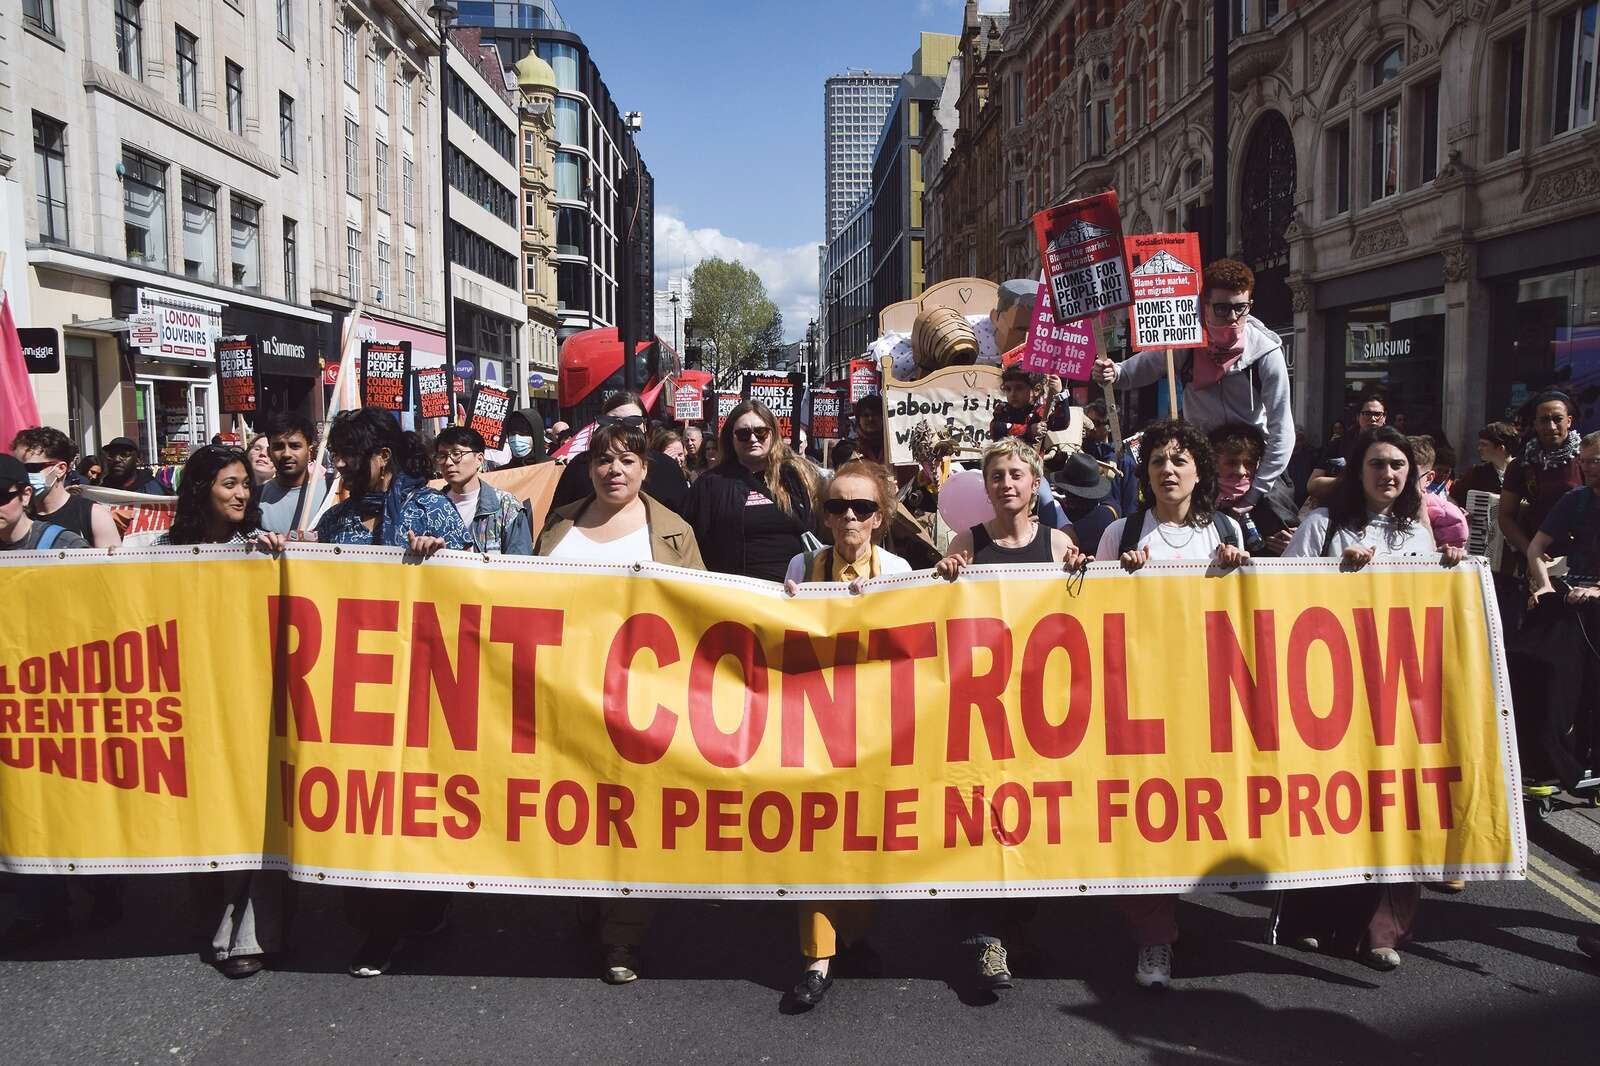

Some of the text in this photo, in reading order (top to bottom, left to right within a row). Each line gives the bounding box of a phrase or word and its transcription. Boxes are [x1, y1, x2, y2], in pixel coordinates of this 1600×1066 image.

[1054, 261, 1117, 292] HOMES FOR
[1134, 276, 1190, 288] Blame the market,
[1058, 282, 1098, 305] PEOPLE
[1101, 275, 1122, 292] NOT
[1148, 286, 1175, 297] migrants
[1060, 289, 1123, 318] FOR PROFIT
[1137, 299, 1194, 316] HOMES FOR
[165, 309, 201, 329] LONDON
[1138, 312, 1197, 330] PEOPLE NOT
[1036, 324, 1088, 344] to blame
[1140, 327, 1197, 344] FOR PROFIT
[246, 349, 252, 359] 4
[271, 336, 305, 359] Summers
[1033, 339, 1061, 356] Stop
[1065, 345, 1085, 359] the
[1364, 339, 1411, 359] SAMSUNG
[221, 359, 253, 371] PEOPLE
[368, 351, 404, 362] HOMES 4
[1030, 354, 1080, 374] far right
[367, 360, 404, 372] PEOPLE
[367, 386, 403, 395] HOUSING
[368, 378, 403, 387] COUNCIL
[420, 380, 447, 389] PEOPLE
[478, 392, 503, 405] HOMES
[751, 386, 793, 397] HOMES 4
[475, 400, 508, 416] PEOPLE
[963, 396, 979, 411] is
[473, 415, 503, 429] COUNCIL
[486, 410, 506, 421] PROFIT
[0, 619, 181, 694] LONDON
[267, 595, 1444, 769] RENT CONTROL NOW
[0, 697, 182, 733] RENTERS
[0, 736, 188, 798] UNION
[506, 778, 638, 848] FOR
[662, 787, 919, 853] PEOPLE
[944, 781, 1073, 848] NOT
[1097, 777, 1228, 843] FOR
[1247, 766, 1463, 839] PROFIT
